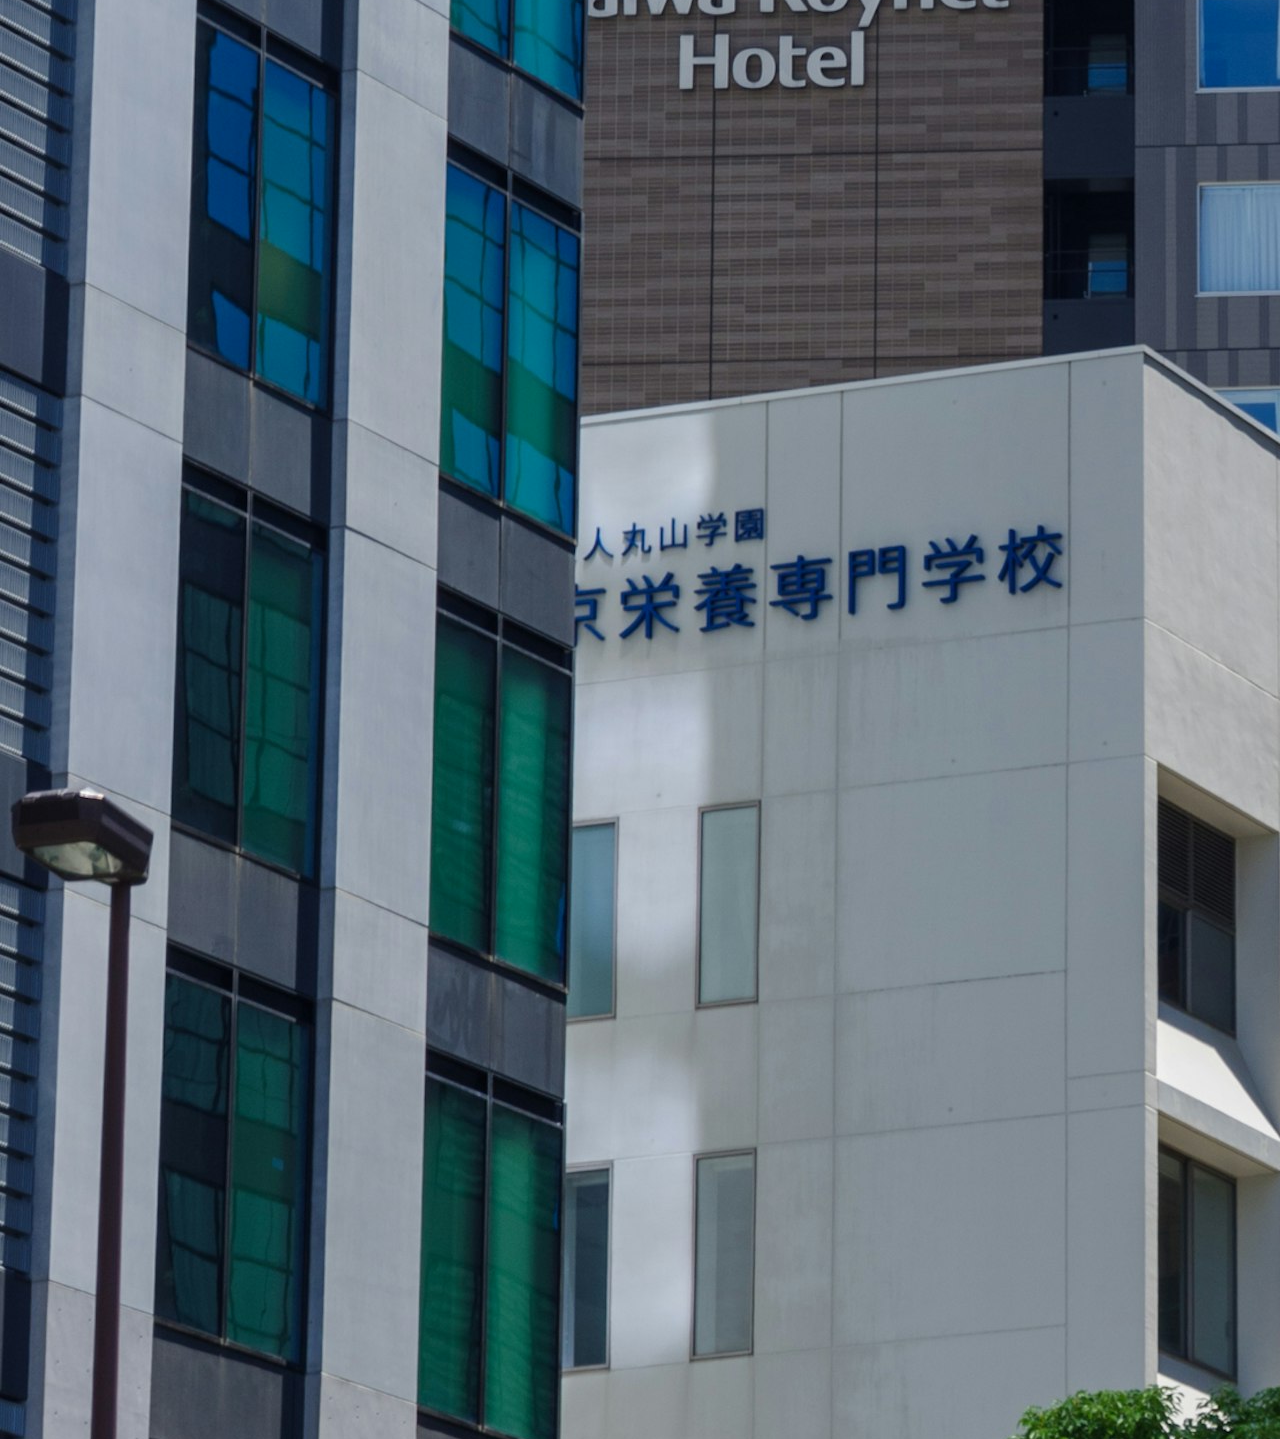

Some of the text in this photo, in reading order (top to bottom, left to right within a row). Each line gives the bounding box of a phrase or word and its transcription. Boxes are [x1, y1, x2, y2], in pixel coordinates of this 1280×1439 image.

[678, 30, 866, 90] Hotel
[583, 507, 767, 562] 人丸山学園
